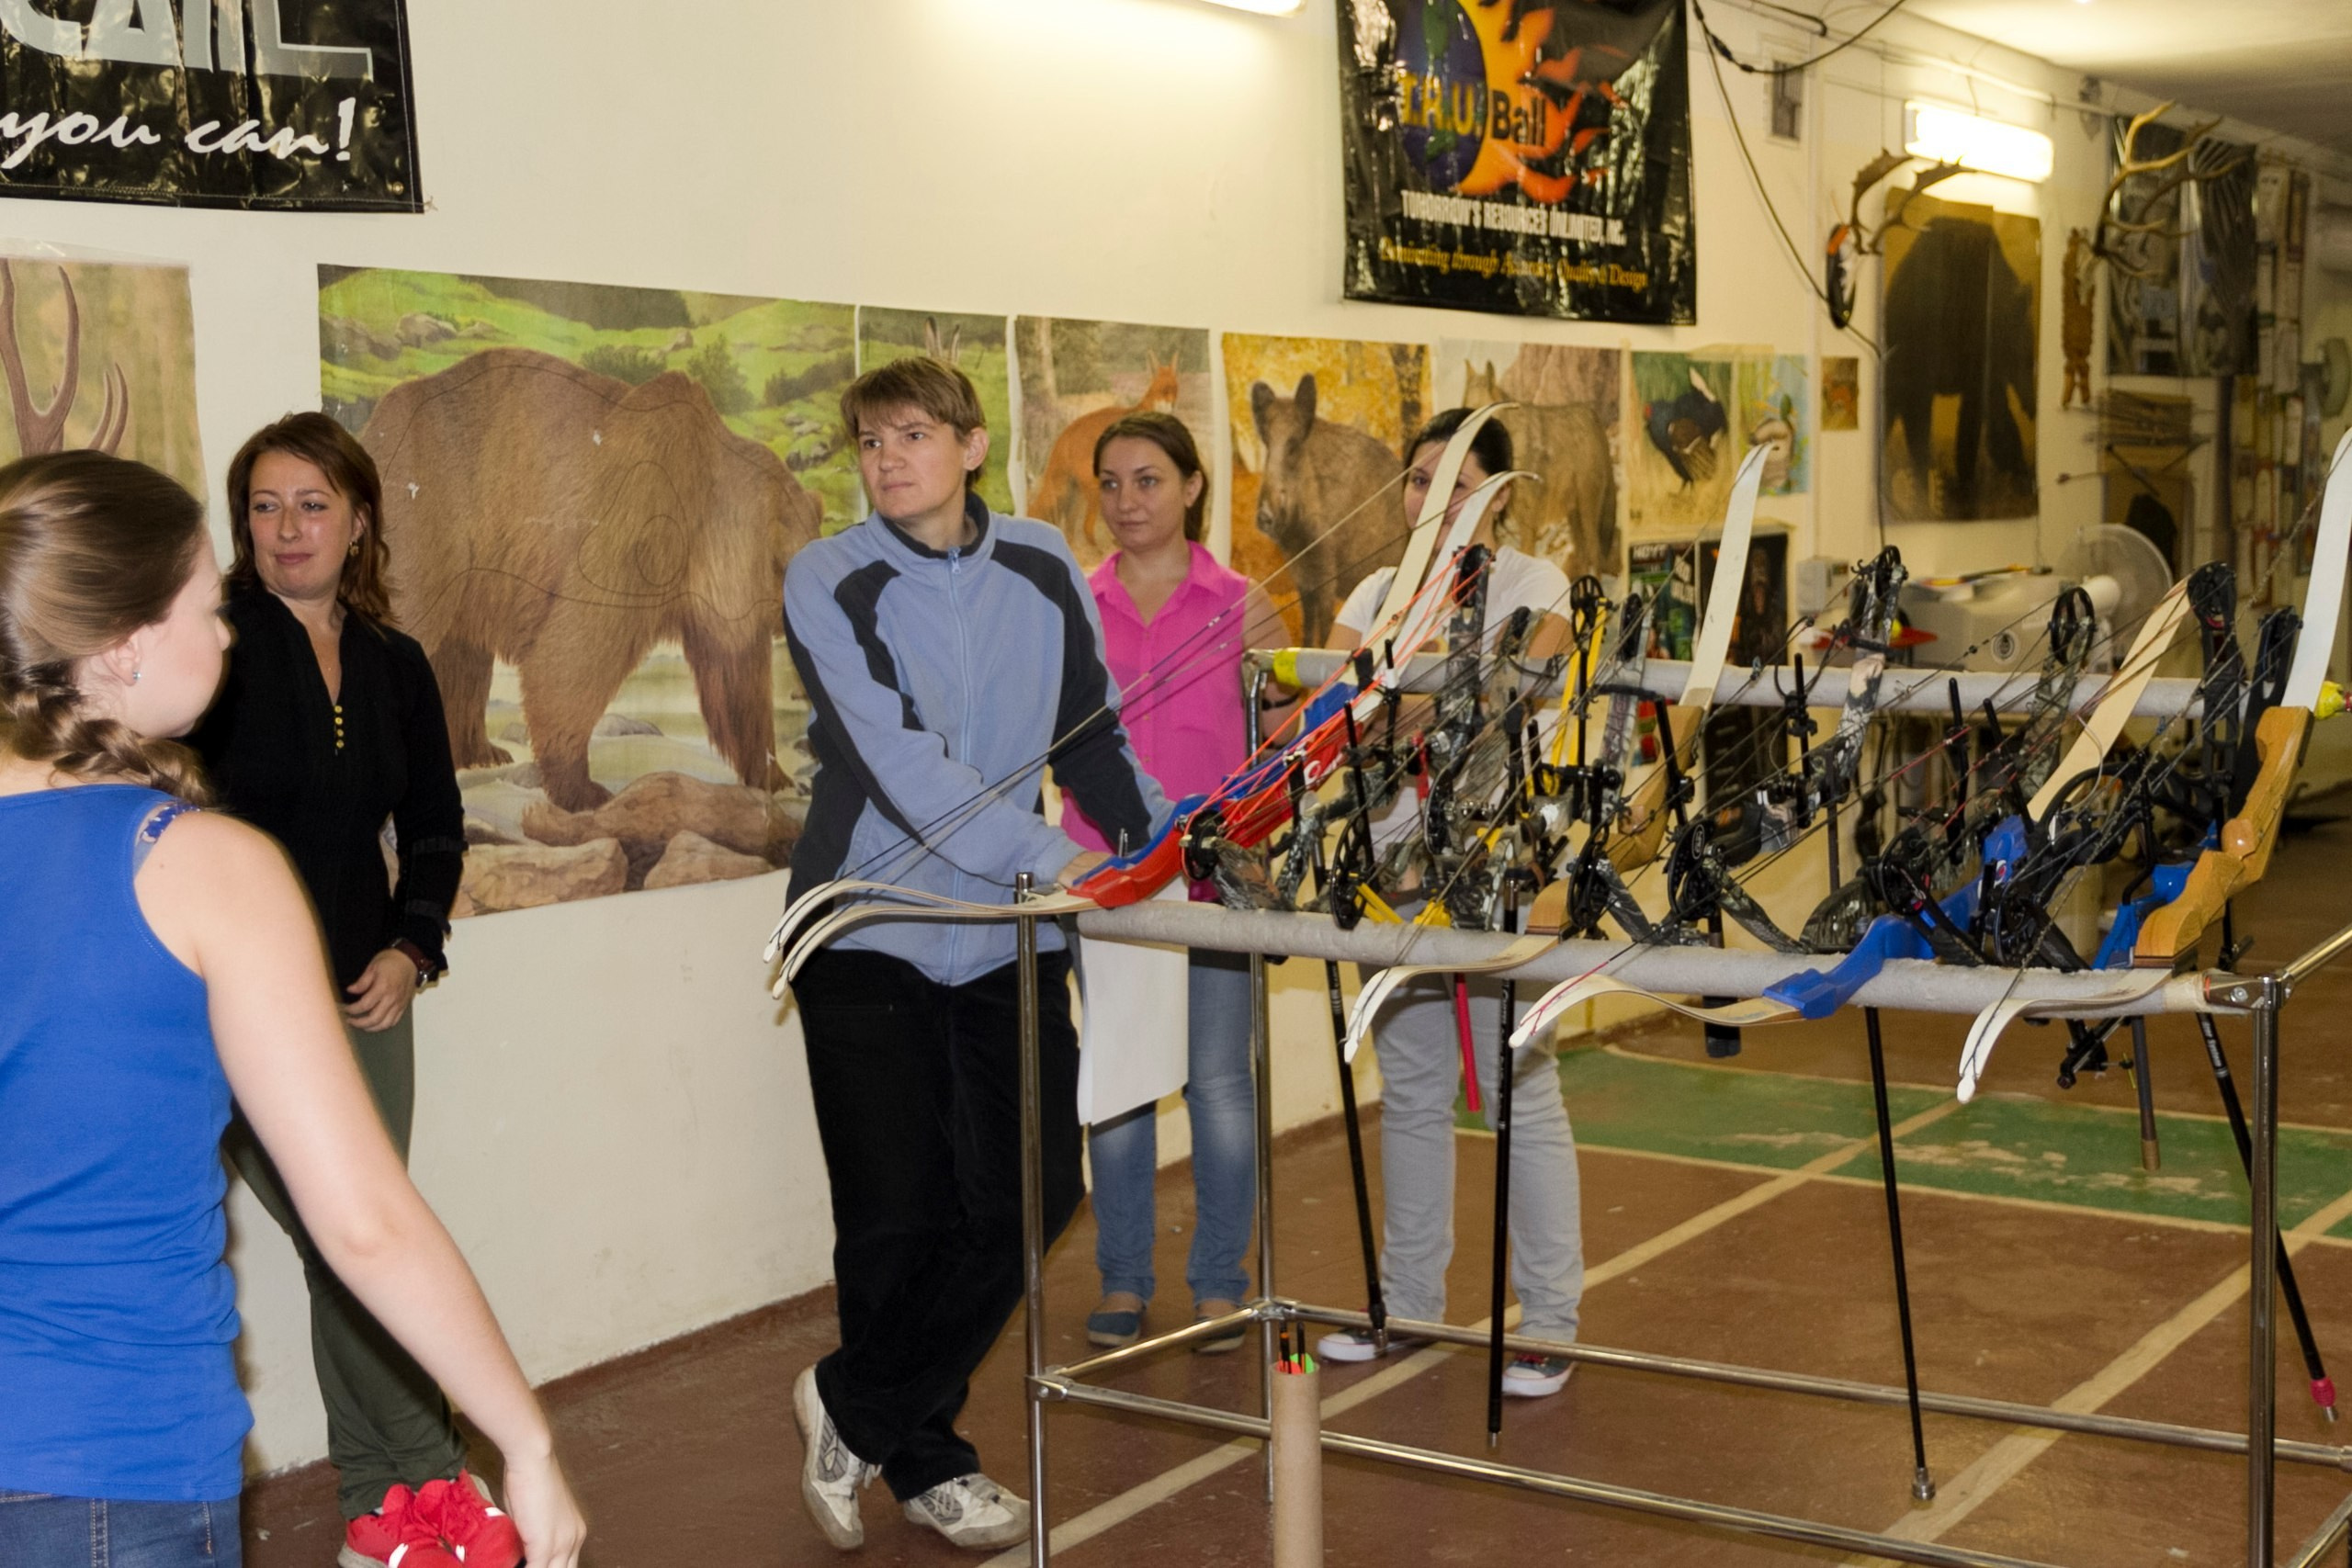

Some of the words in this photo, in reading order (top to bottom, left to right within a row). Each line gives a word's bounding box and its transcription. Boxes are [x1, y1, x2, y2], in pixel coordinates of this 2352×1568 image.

[0, 111, 161, 169] you
[185, 96, 356, 162] can!
[1492, 89, 1546, 147] Ball
